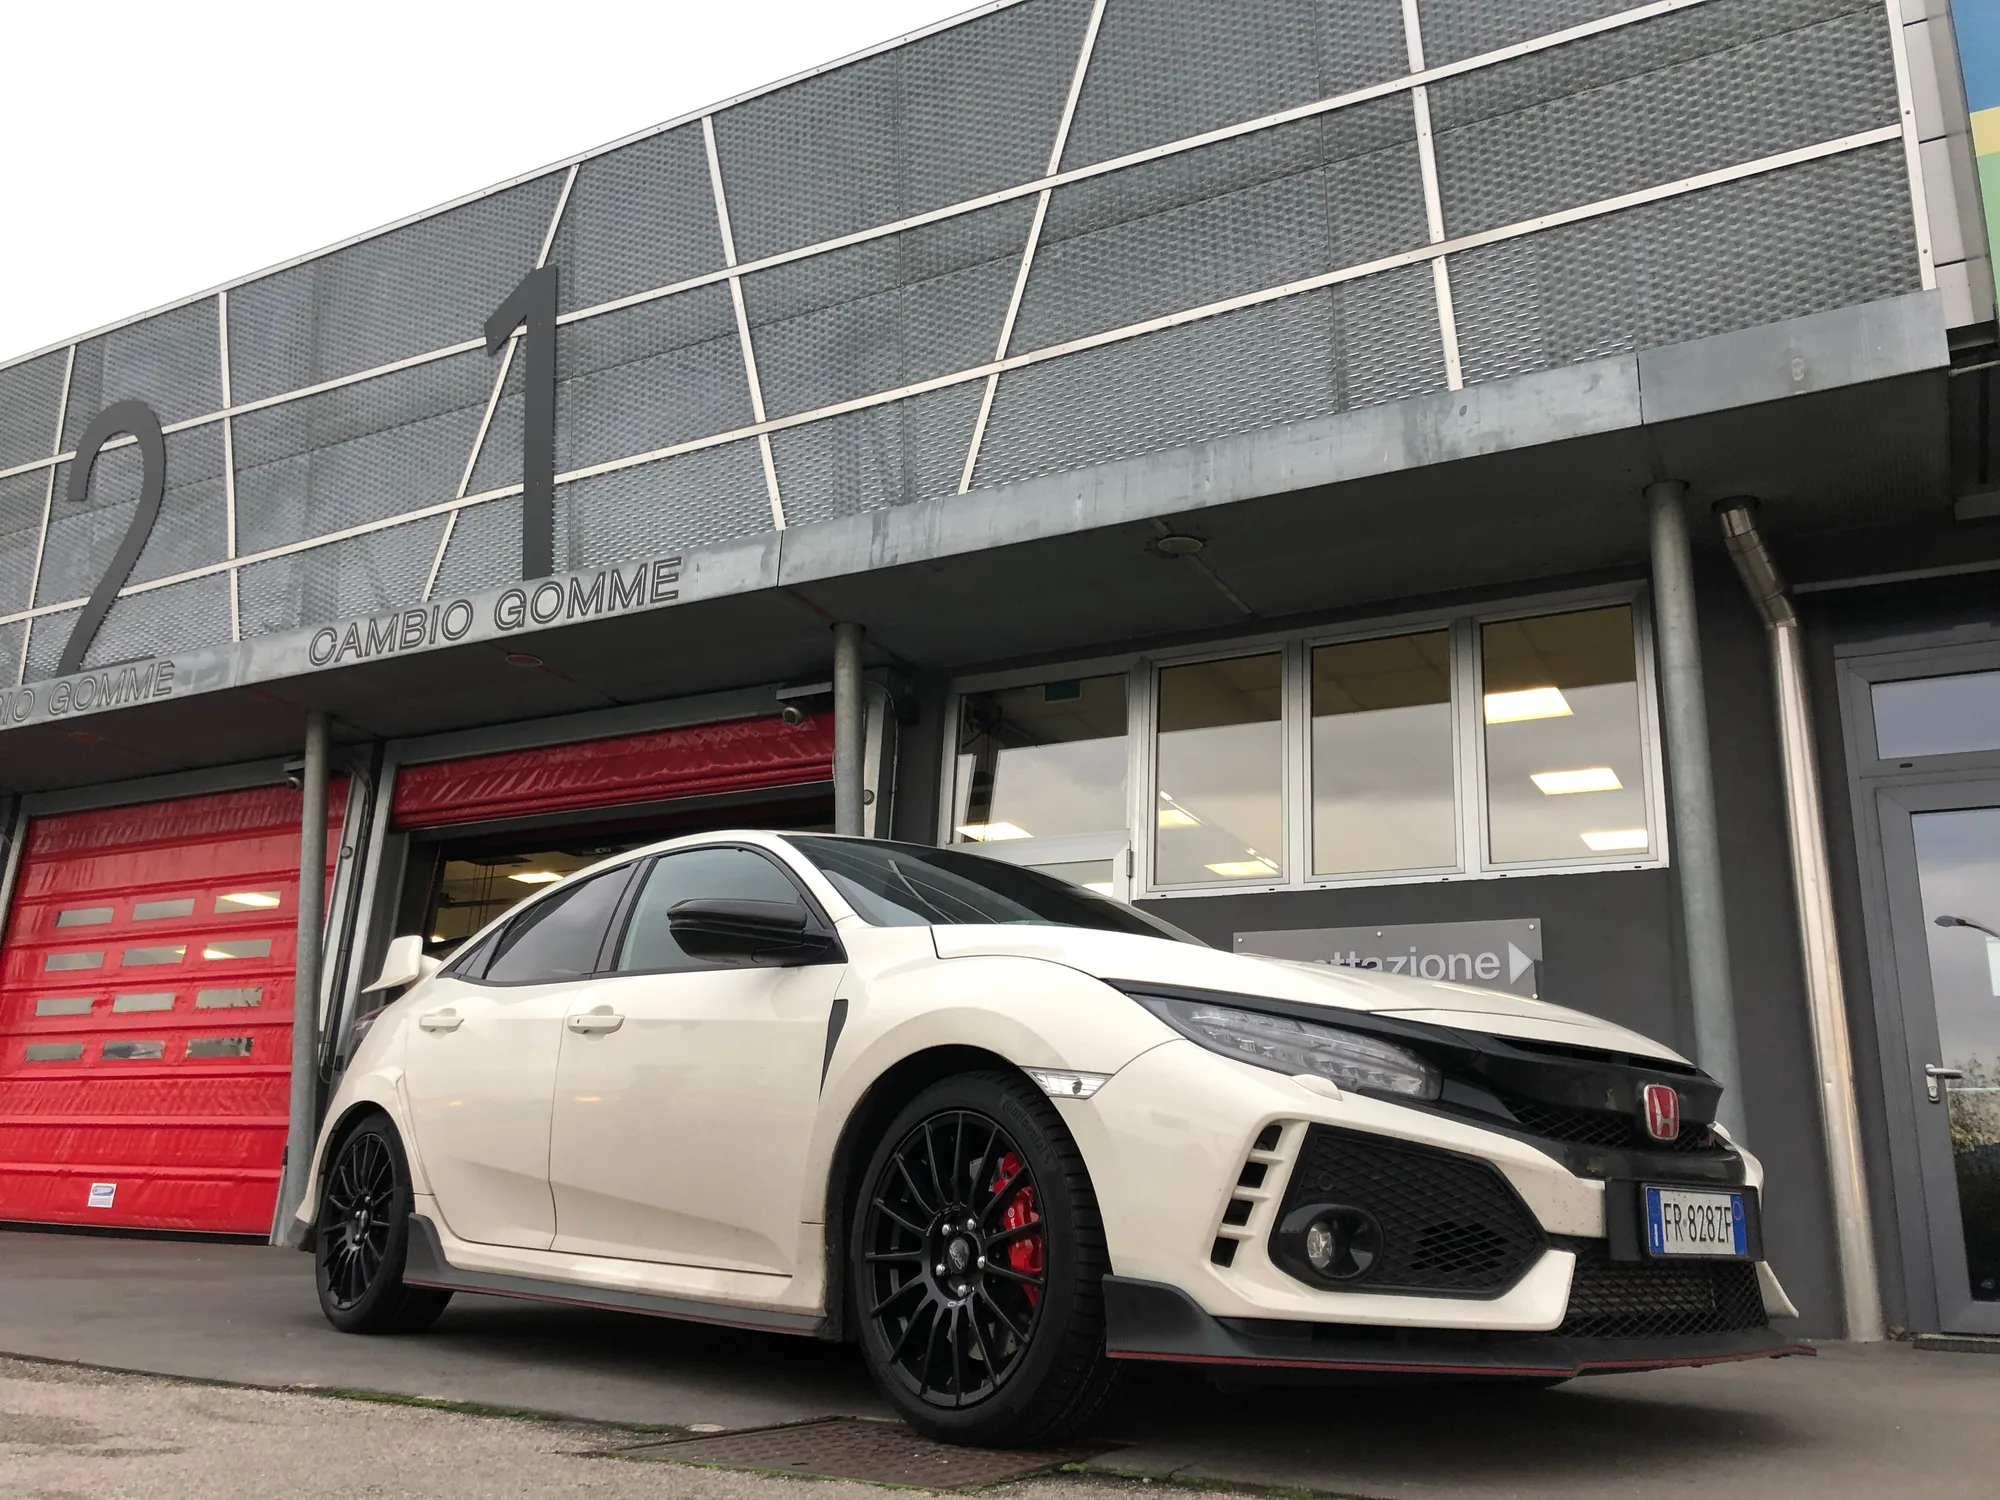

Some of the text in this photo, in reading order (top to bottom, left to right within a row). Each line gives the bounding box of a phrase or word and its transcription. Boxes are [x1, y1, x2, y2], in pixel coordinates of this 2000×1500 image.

[484, 264, 557, 582] 1
[56, 400, 166, 676] 2
[309, 556, 682, 667] CAMBIO GOMME
[0, 660, 175, 726] IO GOMME
